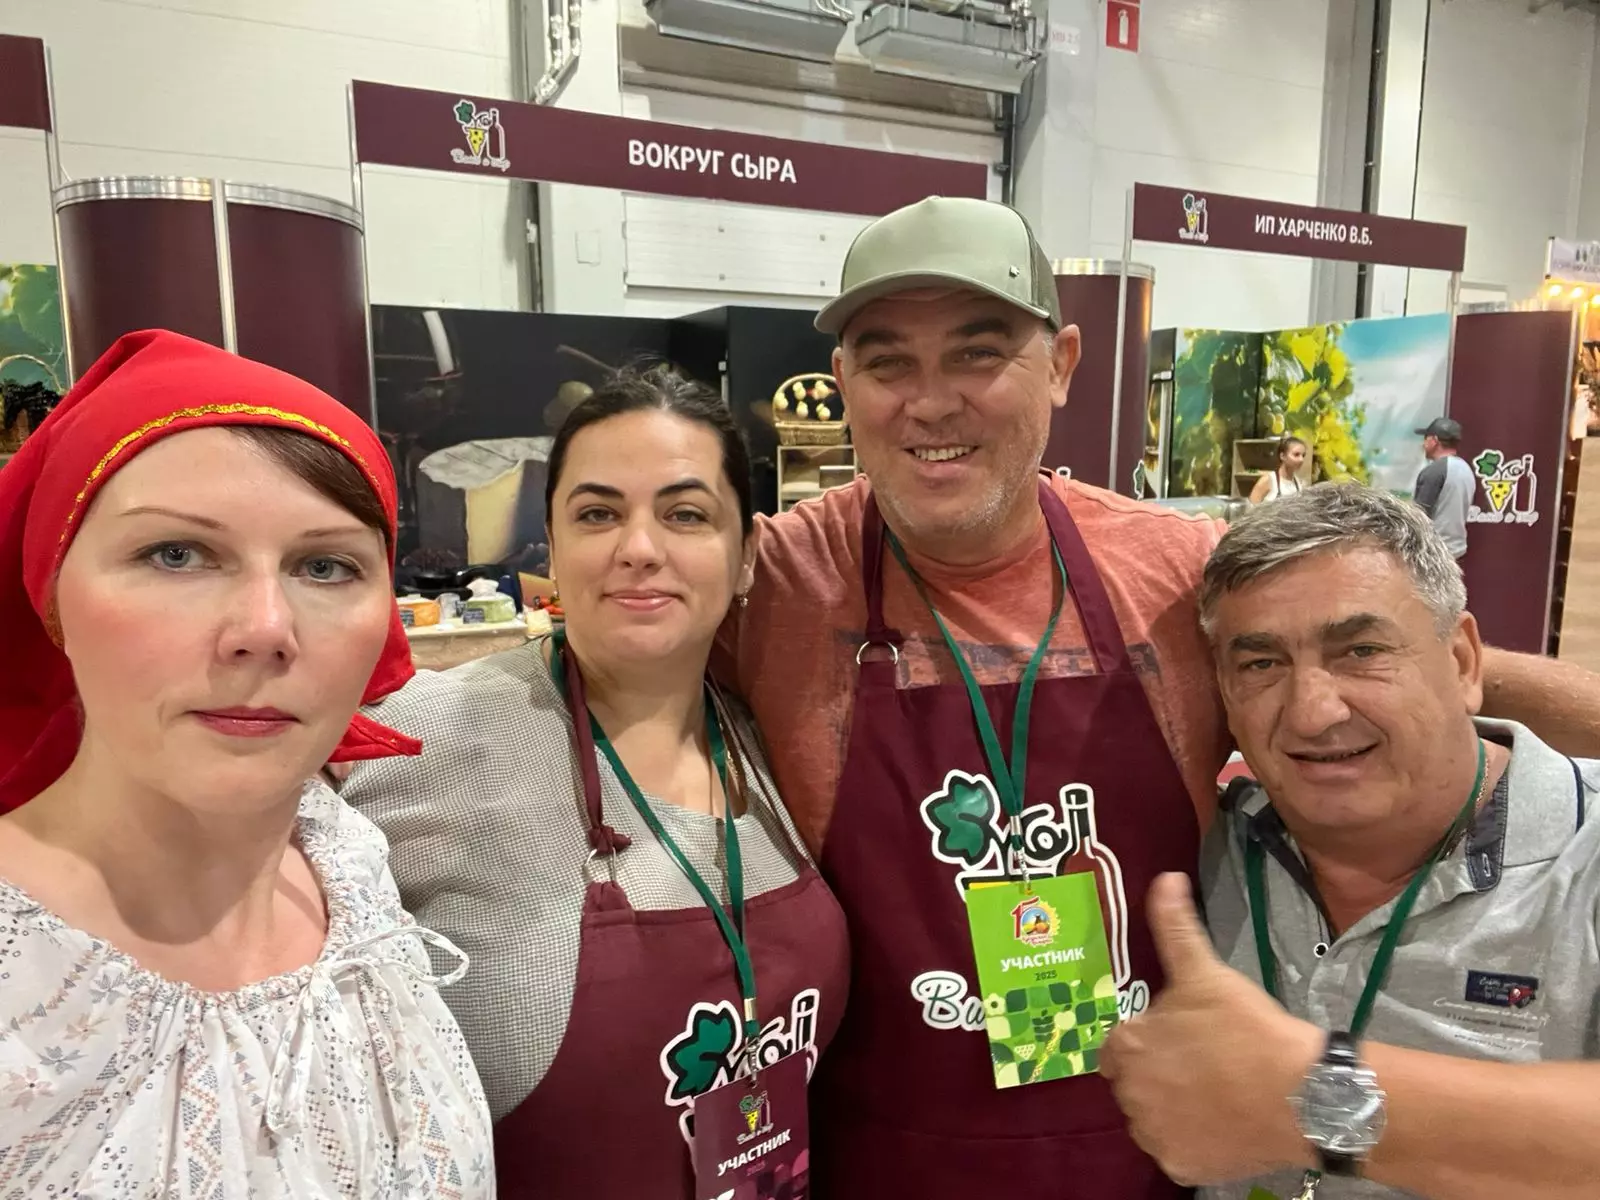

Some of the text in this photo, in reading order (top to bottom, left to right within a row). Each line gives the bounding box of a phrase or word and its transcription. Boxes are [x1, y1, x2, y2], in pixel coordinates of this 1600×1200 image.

[628, 139, 797, 184] ВОКРУГ СЫРА
[1255, 214, 1373, 245] ИП ХАРЧЕНКО В.Б.
[1000, 947, 1085, 972] УЧАСТНИК
[1035, 970, 1058, 981] 2025
[718, 1129, 791, 1177] УЧАСТНИК
